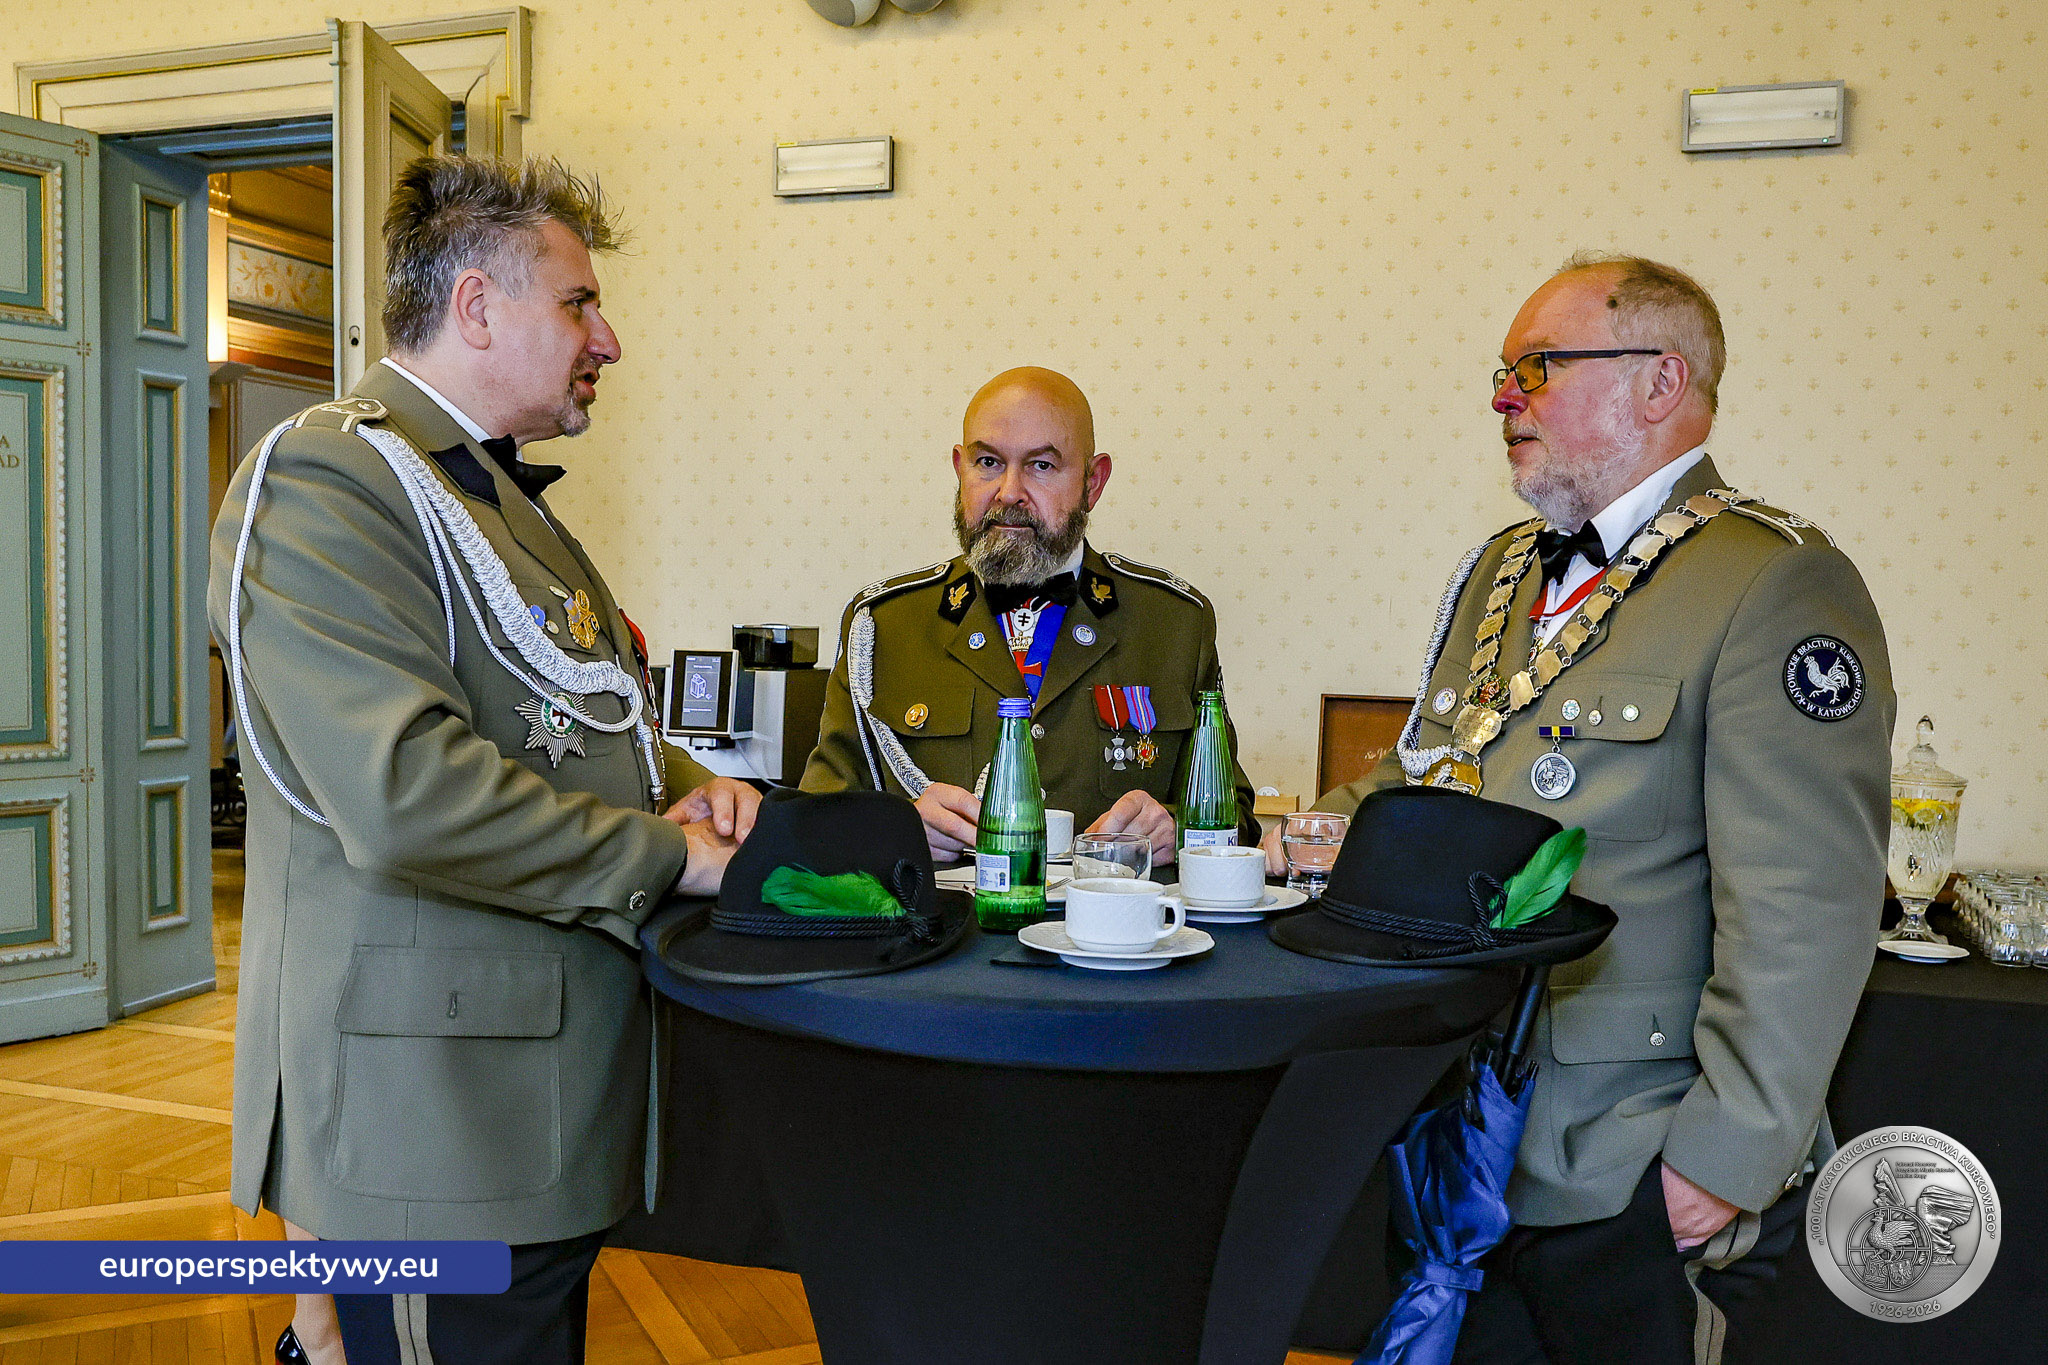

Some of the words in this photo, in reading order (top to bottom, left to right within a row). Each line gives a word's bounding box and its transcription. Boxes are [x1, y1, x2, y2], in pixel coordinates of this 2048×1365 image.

[1787, 654, 1806, 704] KATOWICKIE
[1797, 640, 1836, 656] BRACTWO
[1839, 647, 1862, 685] KURKOWE
[1806, 702, 1816, 712] W
[1818, 688, 1862, 717] KATOWICACH
